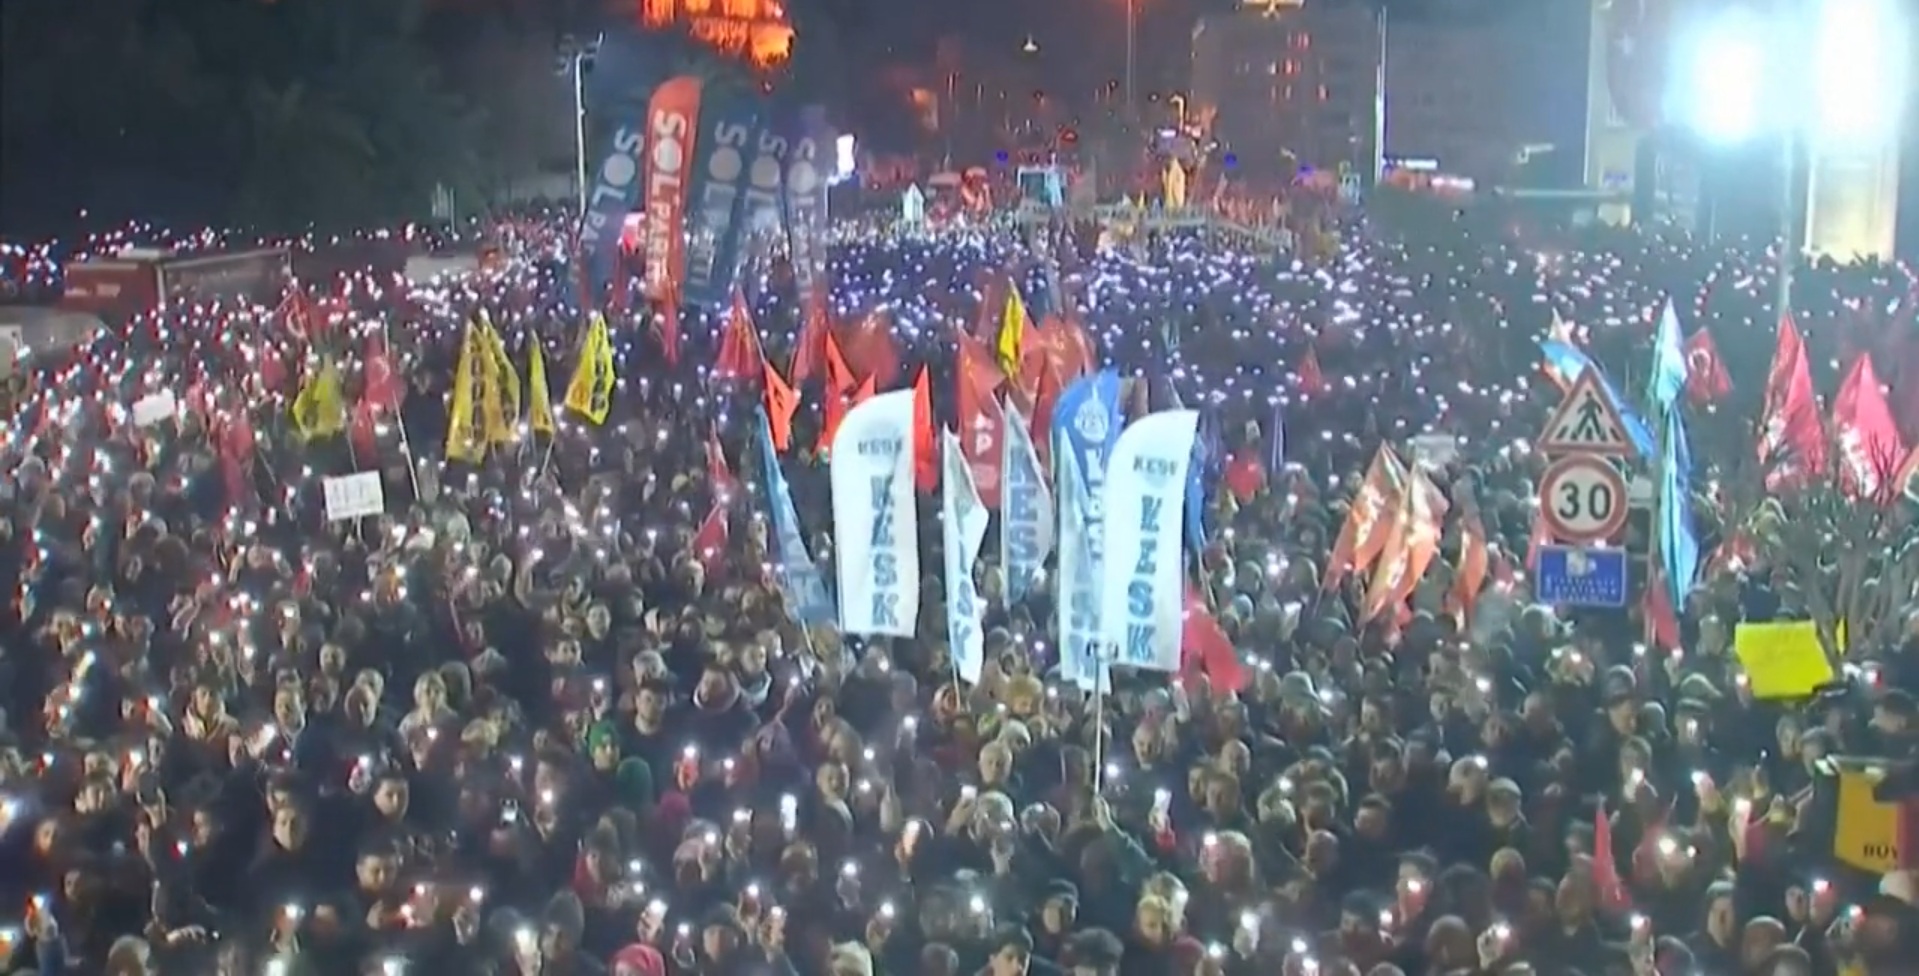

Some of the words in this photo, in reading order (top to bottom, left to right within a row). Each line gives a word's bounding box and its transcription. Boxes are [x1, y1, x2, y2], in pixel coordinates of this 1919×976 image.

[592, 127, 645, 206] SOL
[652, 109, 687, 206] SOL
[704, 121, 747, 205] SOL
[745, 131, 788, 210] SOL
[1559, 481, 1612, 521] 30
